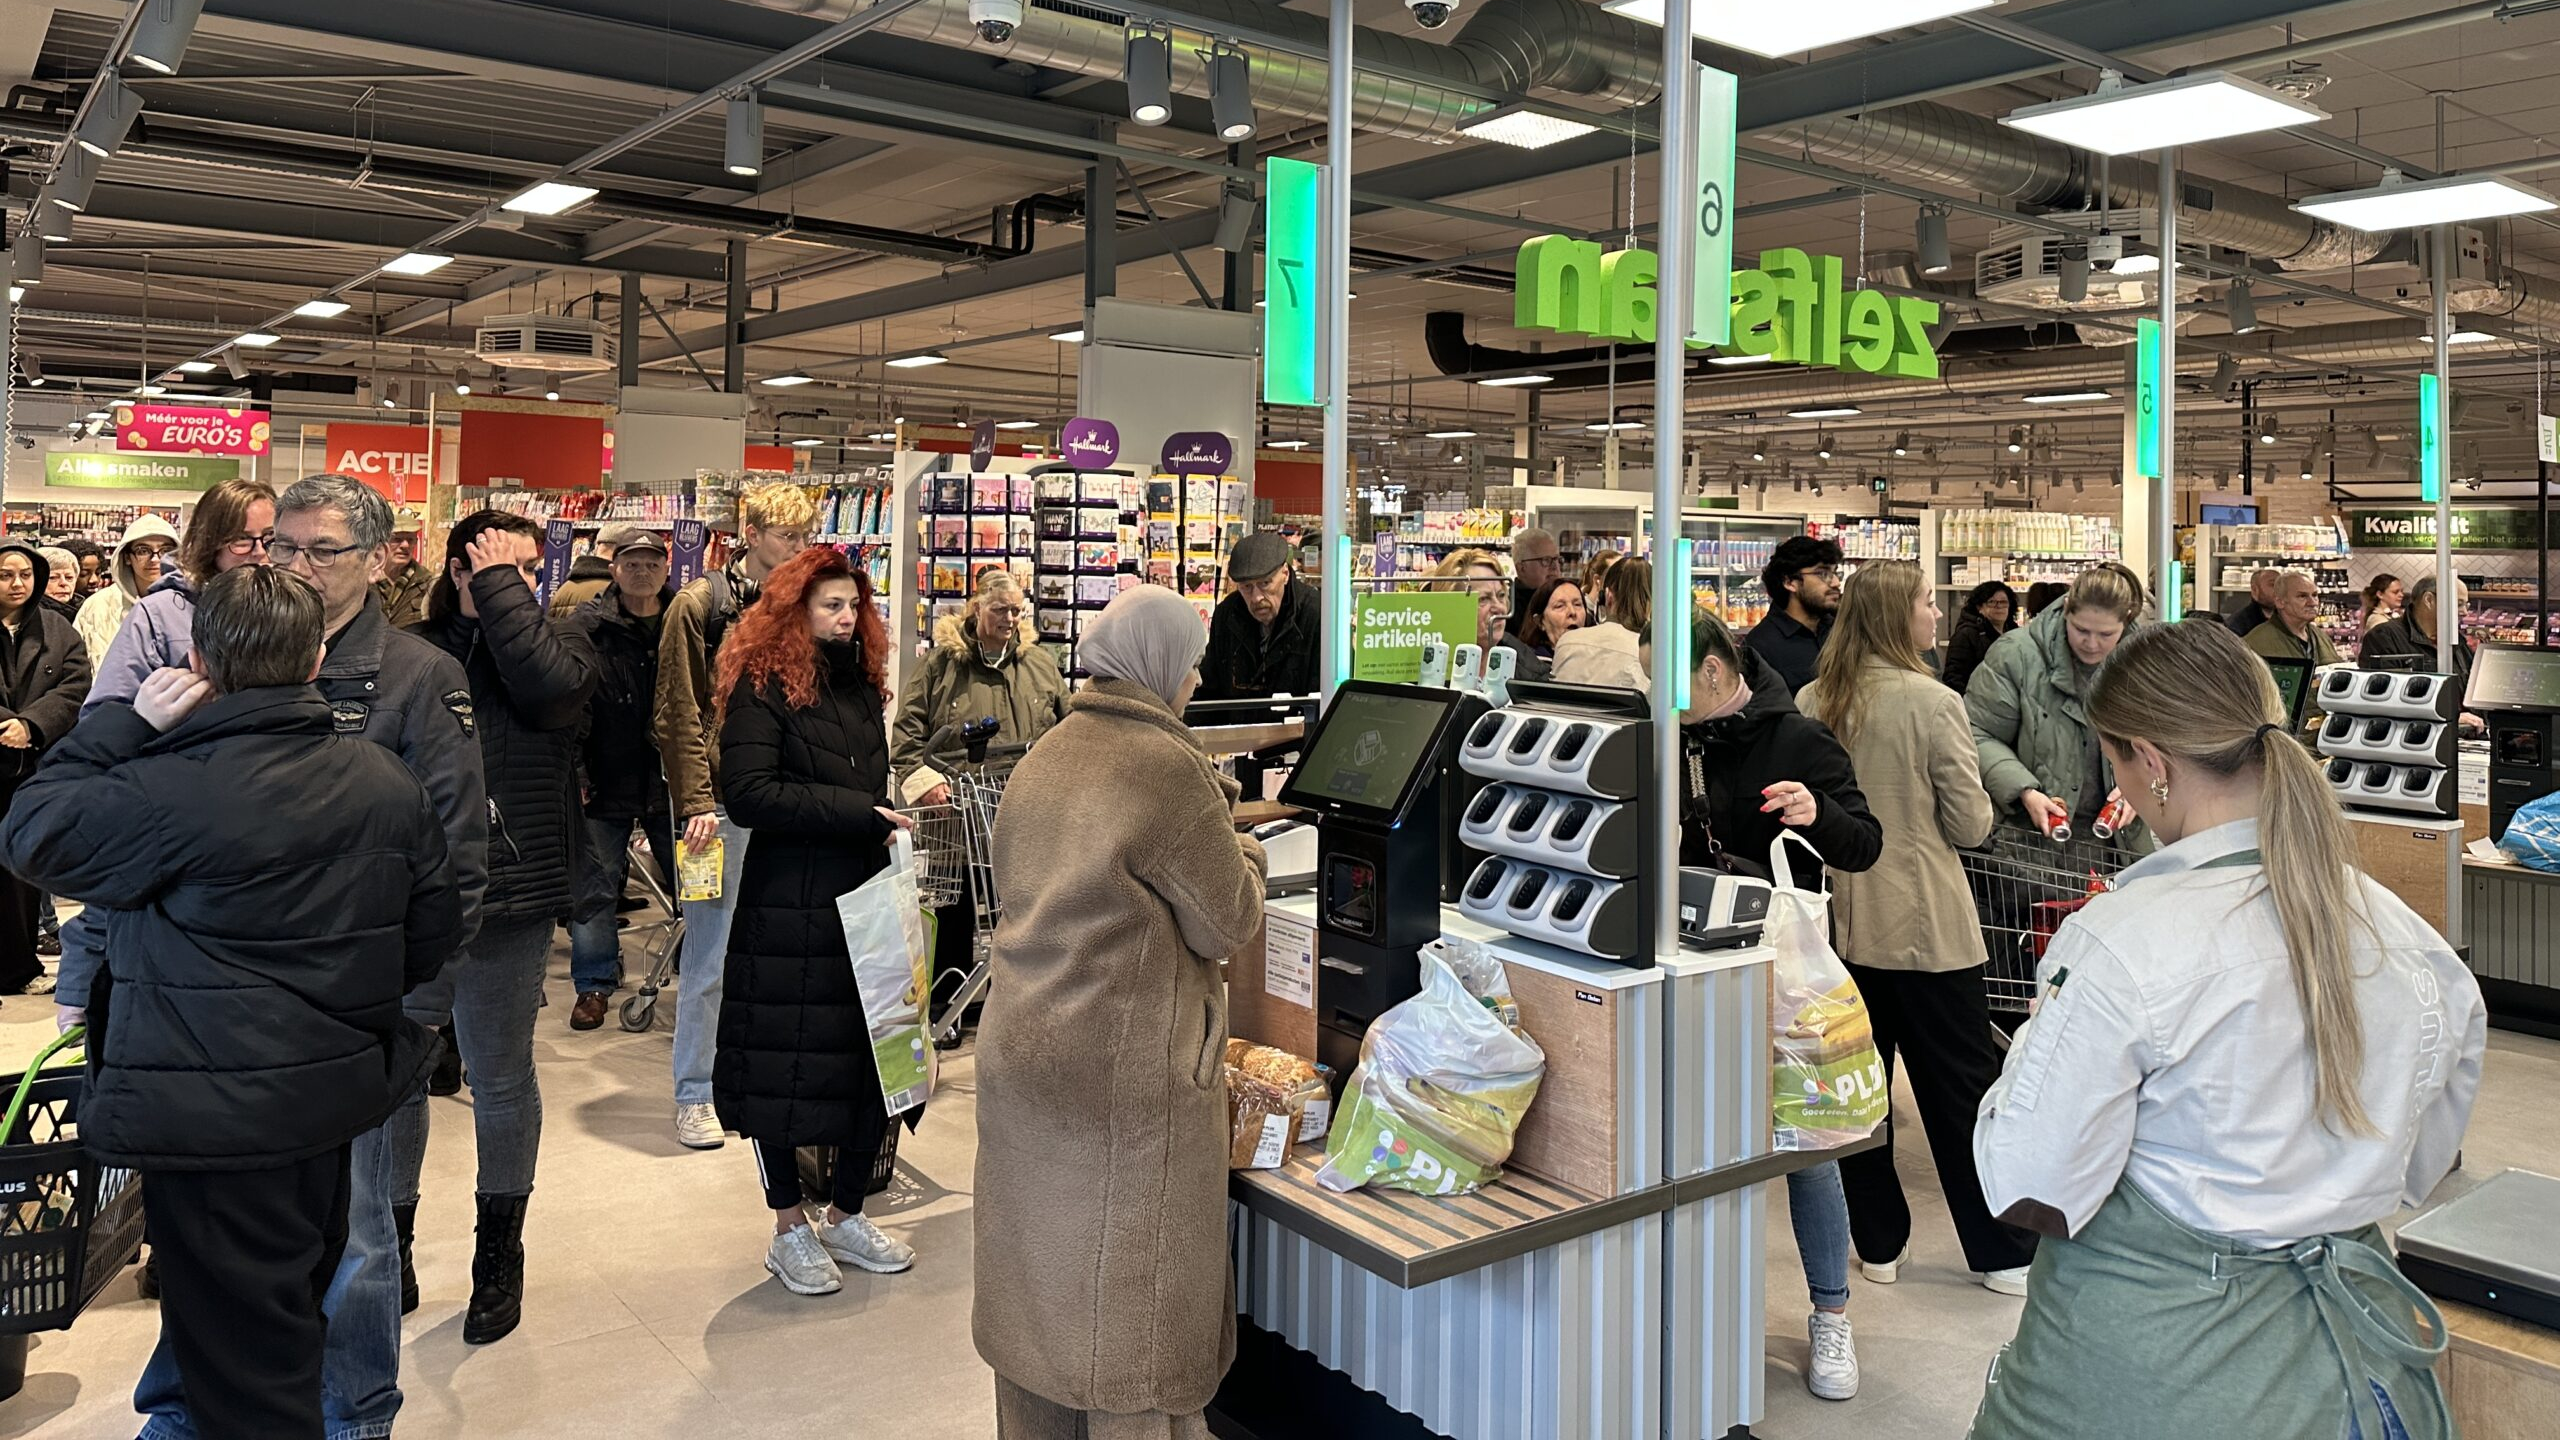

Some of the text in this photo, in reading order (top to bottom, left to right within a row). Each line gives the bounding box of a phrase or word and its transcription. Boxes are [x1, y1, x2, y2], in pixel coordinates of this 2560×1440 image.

[145, 412, 223, 426] Méér voor je
[161, 425, 242, 447] EURO'S
[1069, 437, 1113, 455] Hallmark
[336, 449, 429, 474] ACTIE
[1169, 451, 1223, 464] Hallmark
[107, 461, 189, 478] smaken
[552, 521, 569, 534] LAAG
[680, 522, 700, 536] LAAG
[2365, 516, 2469, 534] Kwalitit
[2384, 534, 2395, 543] bij
[2414, 535, 2438, 543] verde
[2463, 534, 2488, 543] alleen
[2490, 534, 2505, 543] het
[2508, 536, 2538, 544] produc
[1364, 607, 1432, 627] Service
[1363, 628, 1443, 649] artikelen
[2411, 968, 2443, 1112] LUS
[1835, 1065, 1883, 1106] PLU
[1801, 1107, 1825, 1116] Goed
[1826, 1108, 1849, 1116] eten.
